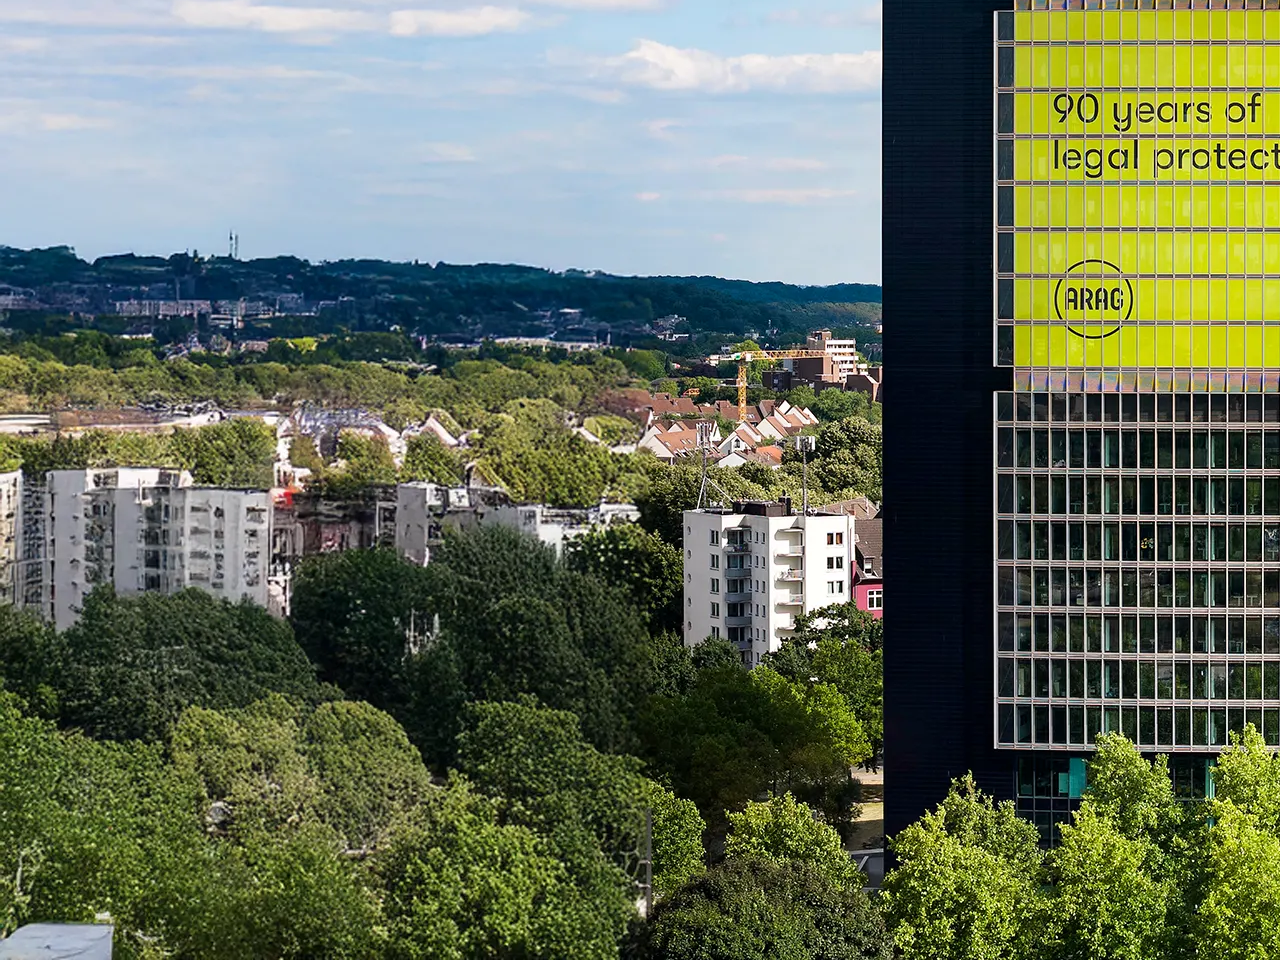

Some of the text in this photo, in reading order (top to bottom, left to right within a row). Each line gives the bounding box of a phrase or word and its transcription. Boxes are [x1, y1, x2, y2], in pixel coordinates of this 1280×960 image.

[1053, 93, 1261, 132] 90 years of
[1053, 140, 1138, 178] legal
[1065, 287, 1124, 311] ARAG
